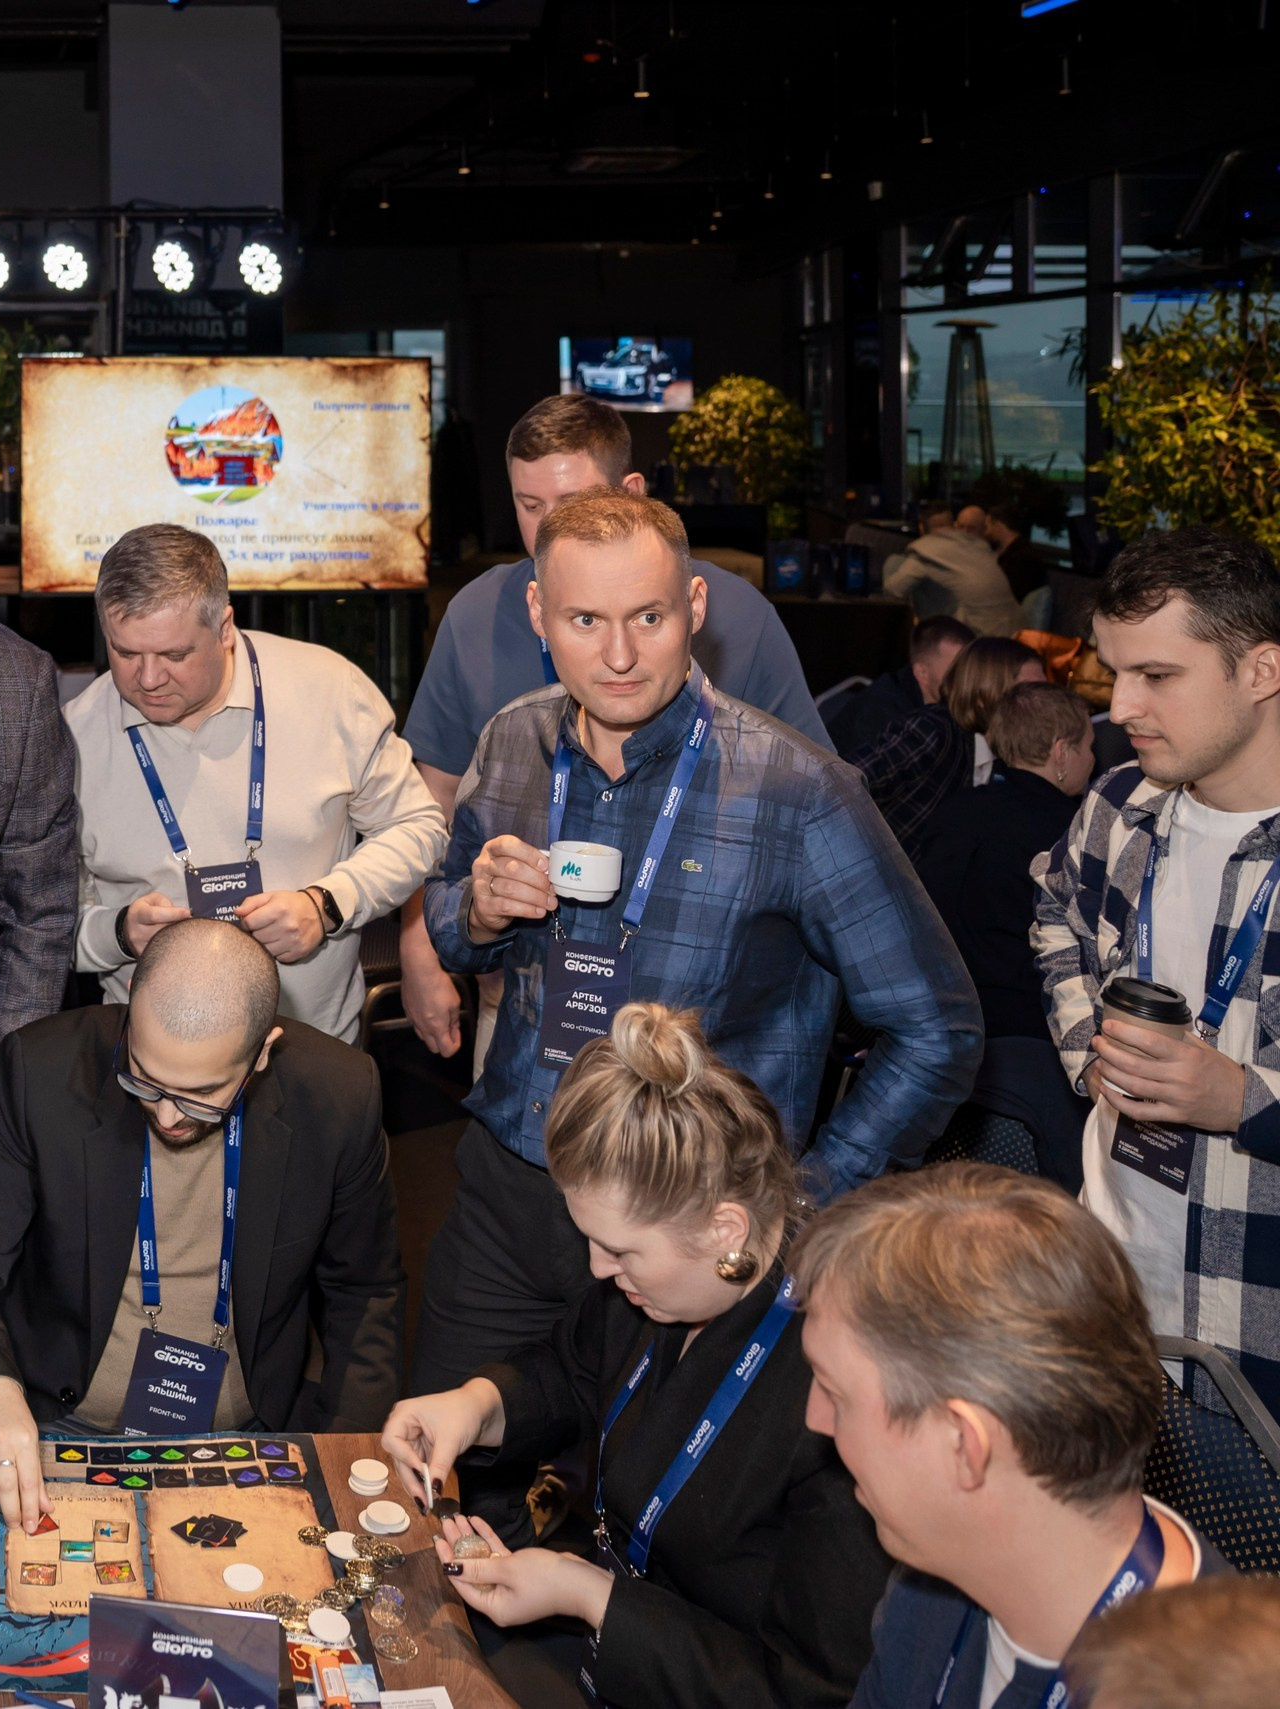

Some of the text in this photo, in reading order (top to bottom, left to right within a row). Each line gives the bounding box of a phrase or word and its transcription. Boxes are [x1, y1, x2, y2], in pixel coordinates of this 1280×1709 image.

[240, 535, 258, 544] не
[262, 534, 325, 546] принесут
[253, 550, 285, 563] карт
[290, 550, 370, 564] разрушены
[689, 717, 703, 748] GloPro
[135, 743, 148, 768] GloPro
[553, 773, 562, 803] GloPro
[663, 785, 679, 817] GloPro
[156, 799, 170, 824] GloPro
[200, 872, 246, 883] КОНФЕРЕНЦИЯ
[560, 861, 582, 877] Me
[637, 857, 652, 889] GloPro
[201, 880, 247, 893] GloPro
[1252, 879, 1270, 912] GloPro
[565, 951, 616, 966] КОНФЕРЕНЦИЯ
[564, 959, 615, 978] GloPro
[1218, 955, 1237, 987] GloPro
[571, 991, 603, 1004] АРТЕМ
[565, 1000, 608, 1015] АРБУЗОВ
[561, 1021, 608, 1036] ООО «СТРИМ24»
[228, 1115, 237, 1146] GloPro
[154, 1349, 206, 1372] GloPro
[164, 1345, 200, 1360] КОМАНДА
[735, 1342, 760, 1377] GloPro
[147, 1384, 197, 1404] ЭЛЬШИМИ
[161, 1378, 188, 1393] ЗИАД
[149, 1406, 186, 1421] FRONT-END
[686, 1419, 711, 1454] GloPro
[638, 1495, 660, 1531] GloPro
[49, 1600, 88, 1609] НДУК
[152, 1631, 214, 1647] КОНФЕРЕНЦИЯ
[152, 1640, 214, 1659] GloPro
[1046, 1681, 1066, 1709] Glo
